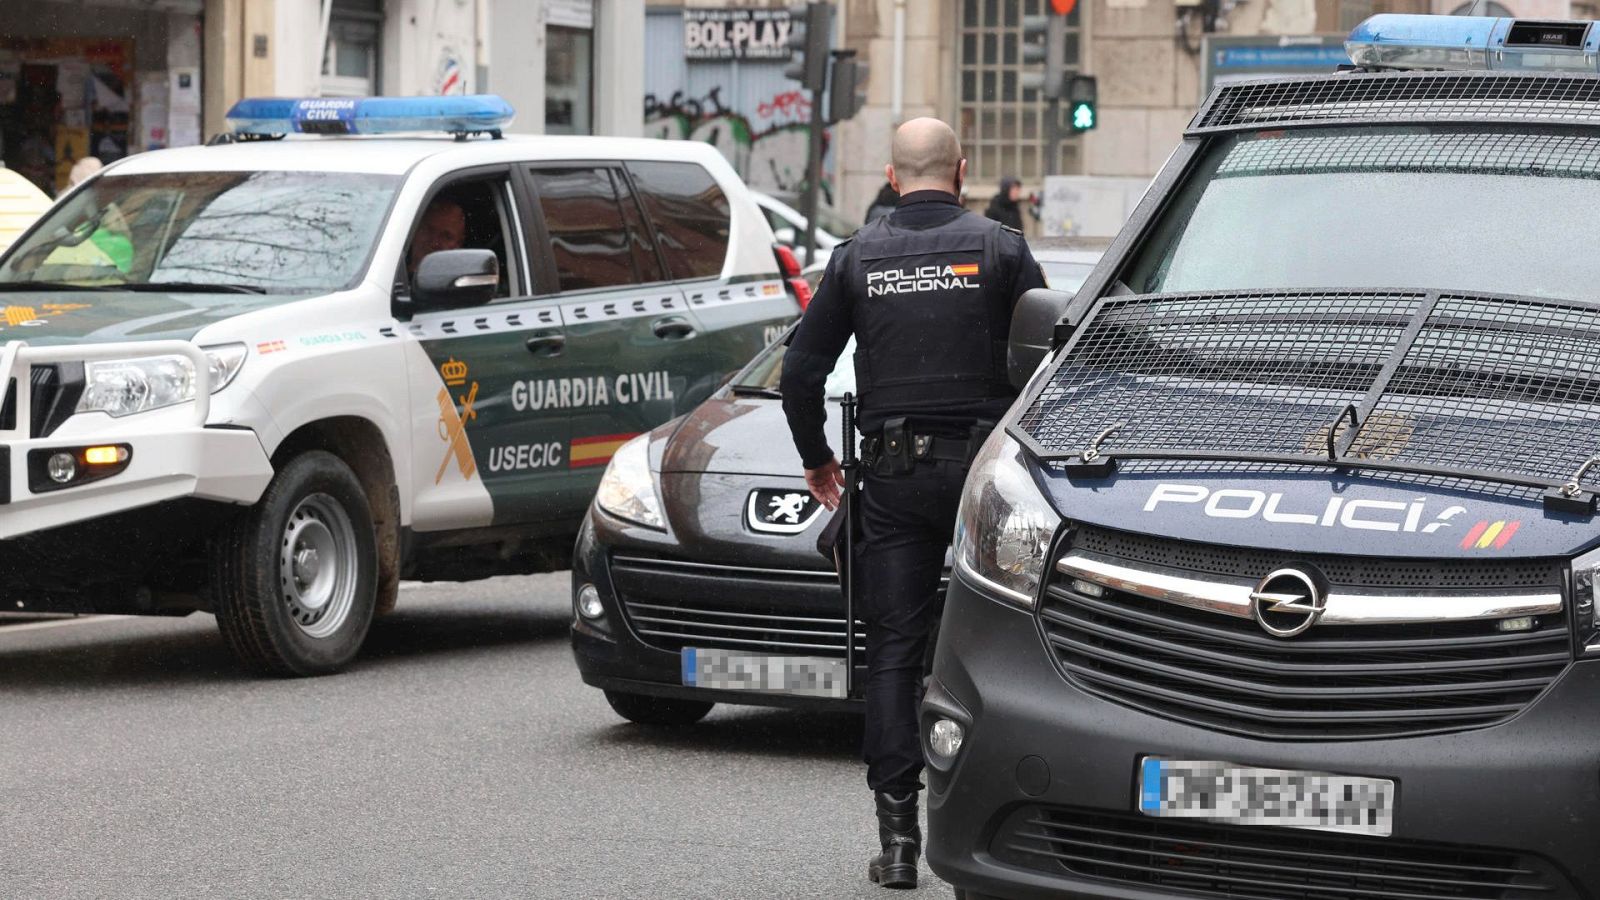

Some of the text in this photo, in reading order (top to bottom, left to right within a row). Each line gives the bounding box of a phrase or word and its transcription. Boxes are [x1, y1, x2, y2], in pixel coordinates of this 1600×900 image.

[300, 100, 354, 109] GUARDIA
[306, 109, 339, 120] CIVIL
[866, 265, 956, 285] POLICIA
[867, 276, 980, 298] NACIONAL
[511, 370, 674, 412] GUARDIA CIVIL
[488, 442, 562, 472] USECIC
